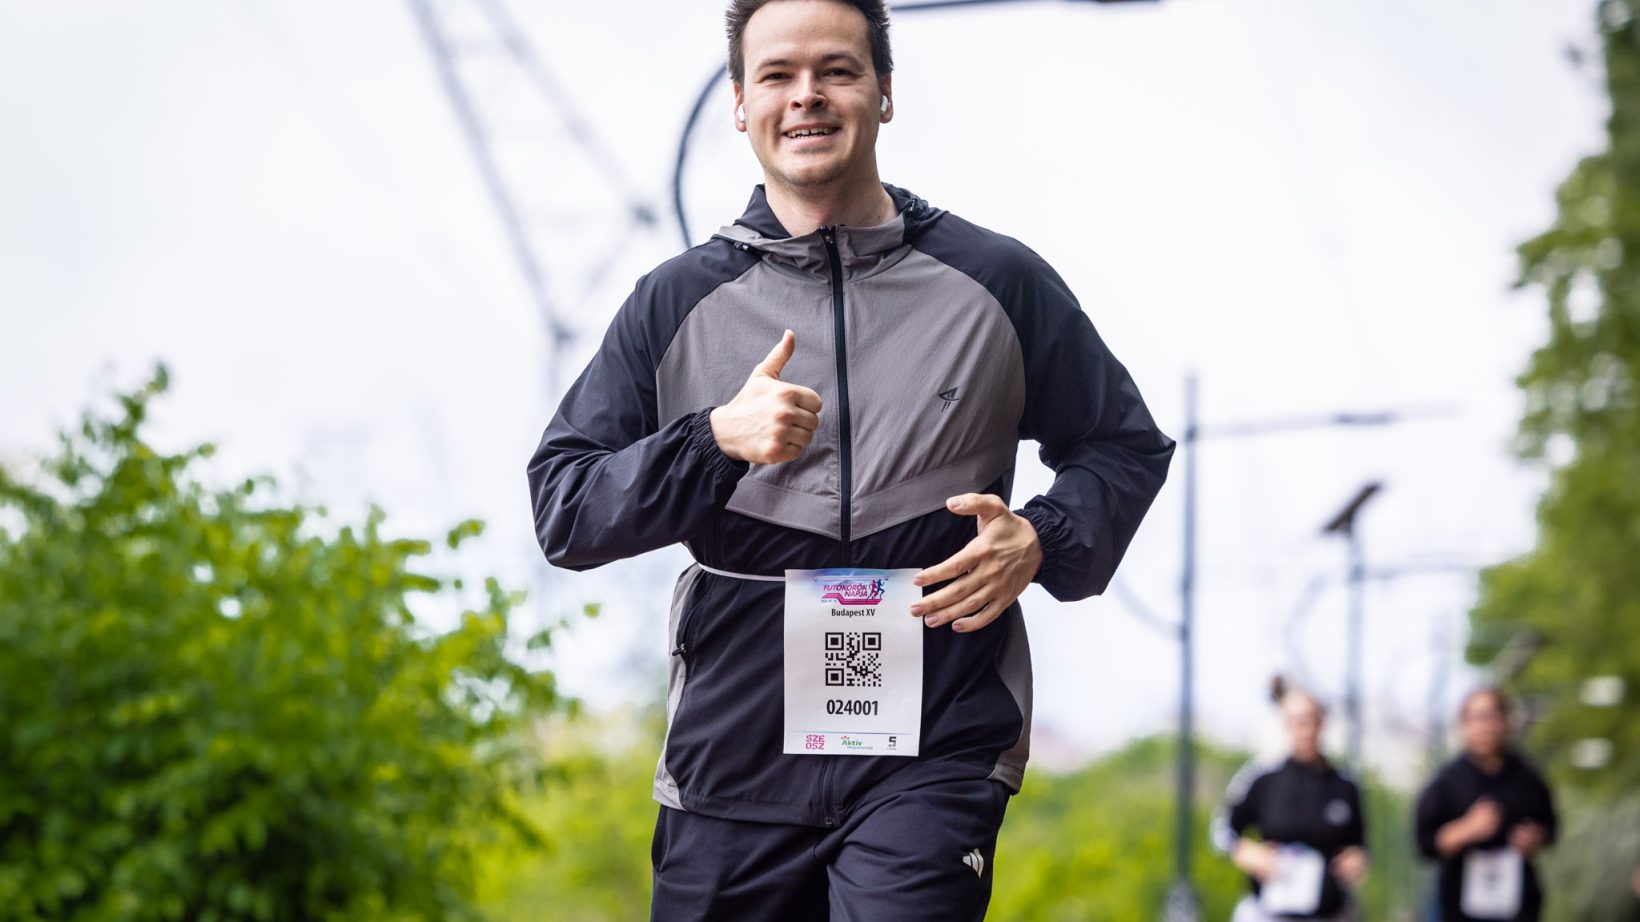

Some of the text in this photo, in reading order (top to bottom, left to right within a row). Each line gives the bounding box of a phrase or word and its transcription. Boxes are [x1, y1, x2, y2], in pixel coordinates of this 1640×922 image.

[831, 609, 865, 618] Budapest
[827, 699, 878, 716] 024001
[805, 742, 825, 750] OSZ
